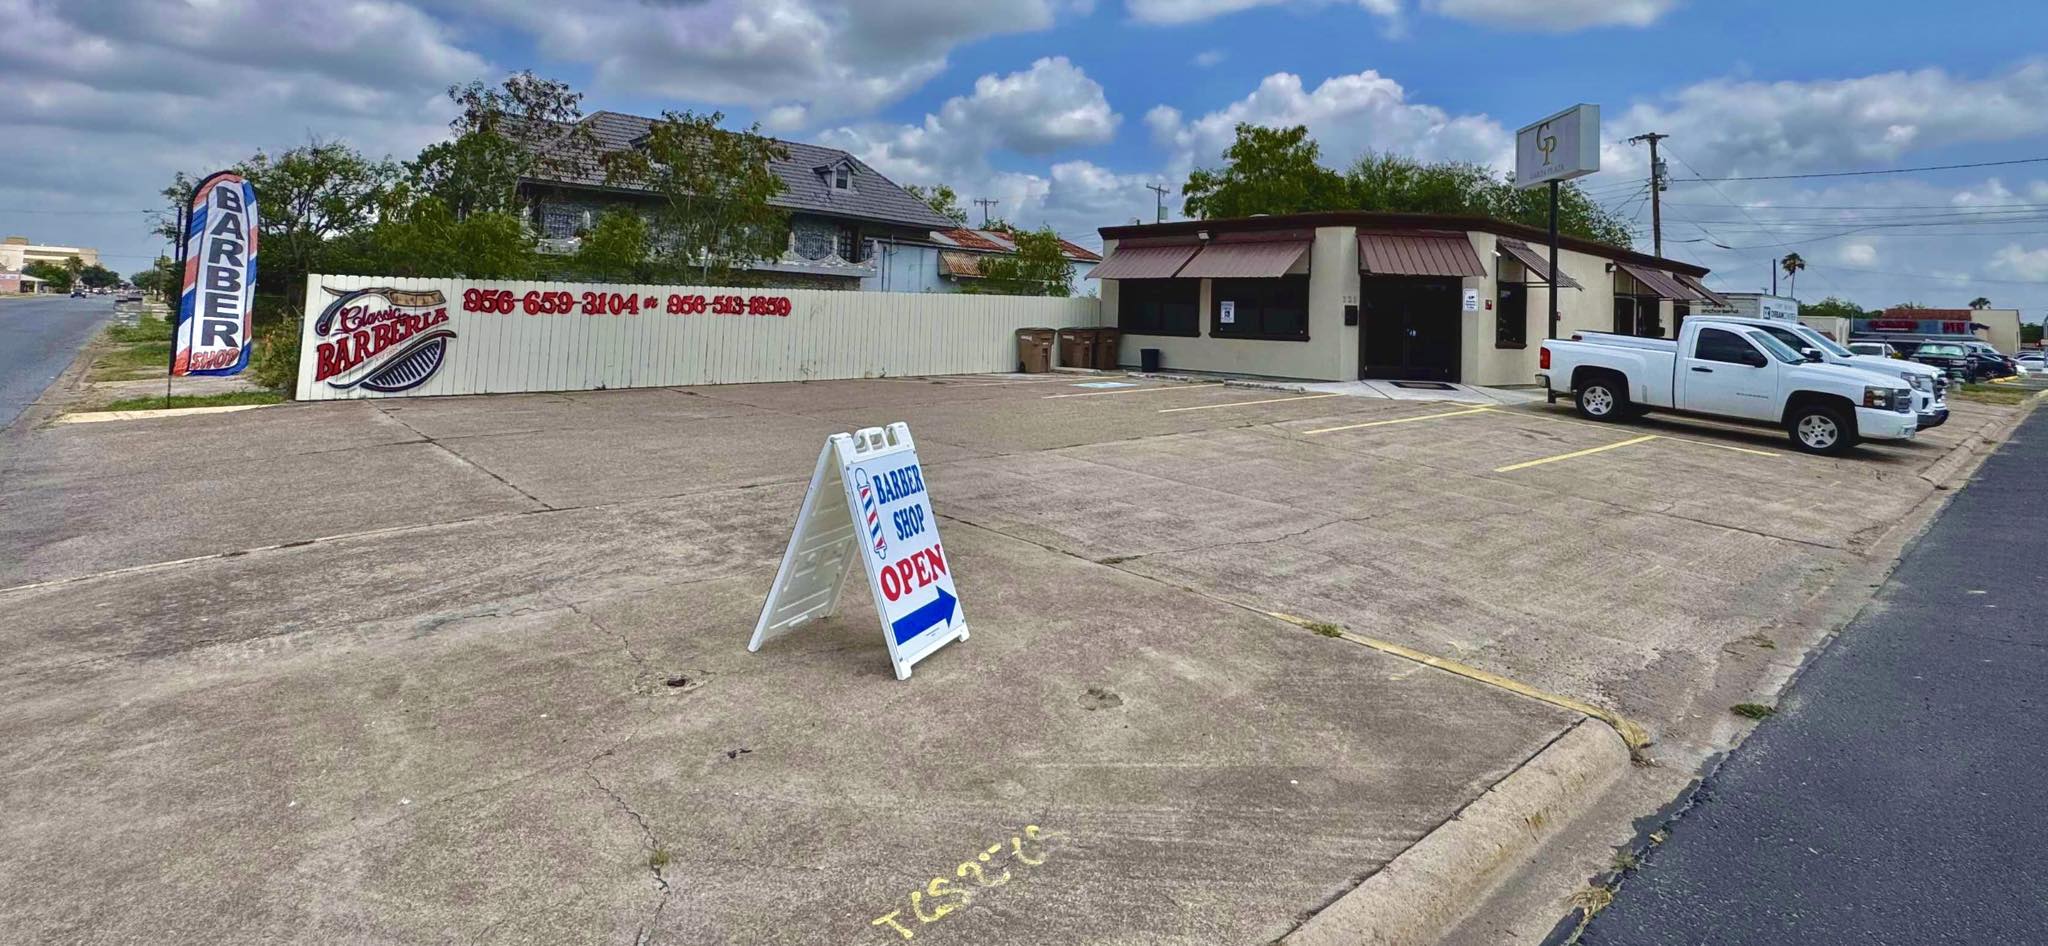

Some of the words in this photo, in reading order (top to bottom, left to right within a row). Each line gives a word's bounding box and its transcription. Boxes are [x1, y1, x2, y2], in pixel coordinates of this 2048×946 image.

[200, 186, 245, 348] BARBER
[335, 305, 403, 334] Classic
[463, 288, 639, 316] 956-659-3104
[191, 347, 240, 371] SHOP
[315, 307, 449, 382] BARBERIA
[873, 464, 925, 505] BARBER
[893, 504, 925, 541] SHOP
[880, 543, 947, 602] OPEN
